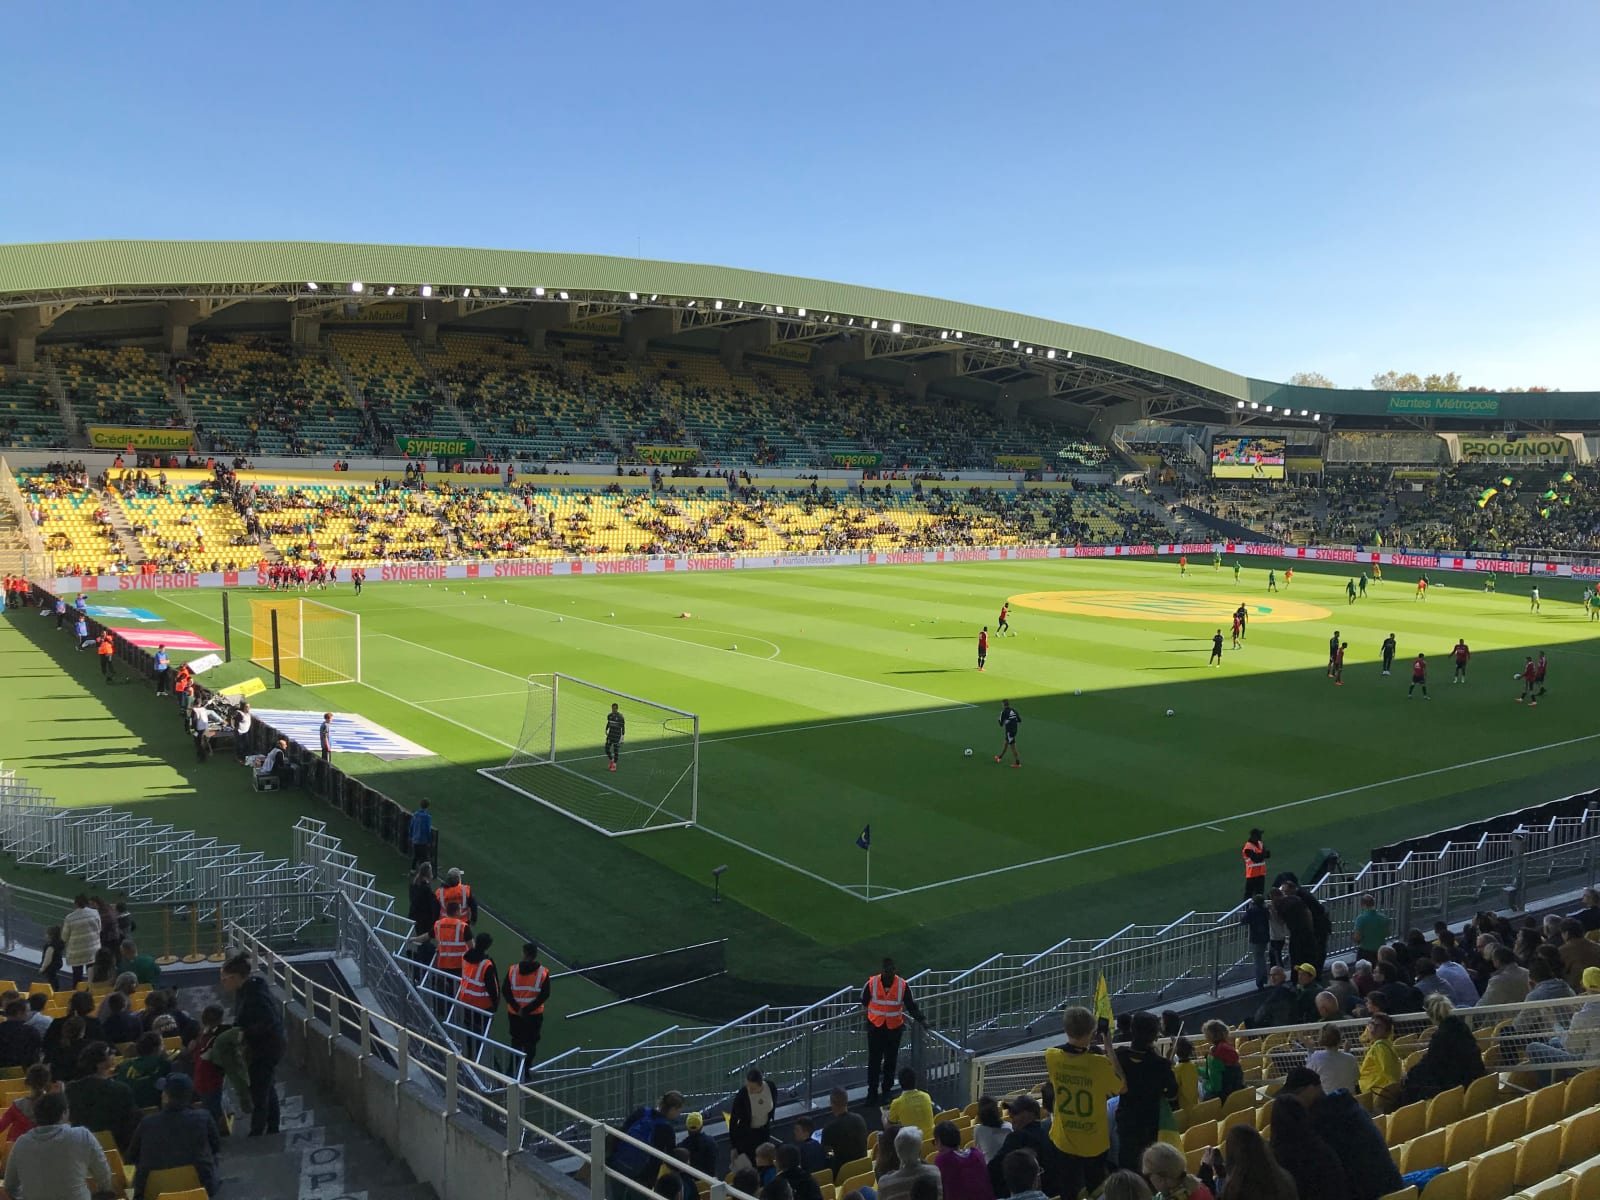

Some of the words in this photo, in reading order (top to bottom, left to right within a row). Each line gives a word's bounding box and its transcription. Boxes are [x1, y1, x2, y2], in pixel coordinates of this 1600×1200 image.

[1390, 397, 1432, 408] Nantes
[1435, 398, 1498, 411] Métropole
[94, 433, 132, 444] Crédit
[148, 434, 190, 446] Mutuel
[407, 440, 467, 455] SYNERGIE
[652, 449, 697, 460] NANTES
[953, 550, 990, 561] SYNERGIE
[1015, 548, 1050, 559] SYNERGIE
[1074, 547, 1106, 557] SYNERGIE
[1181, 544, 1213, 554] SYNERGIE
[1246, 544, 1285, 557] SYNERGIE
[1315, 549, 1357, 562] SYNERGIE
[687, 557, 735, 570] SYNERGIE
[886, 551, 924, 564] SYNERGIE
[1391, 554, 1438, 567] SYNERGIE
[494, 562, 553, 577] SYNERGIE
[596, 559, 649, 573] SYNERGIE
[1475, 559, 1529, 574] SYNERGIE
[381, 565, 448, 581] SYNERGIE
[119, 573, 200, 590] SYNERGIE
[1057, 1086, 1094, 1118] 20
[308, 1172, 338, 1190] P
